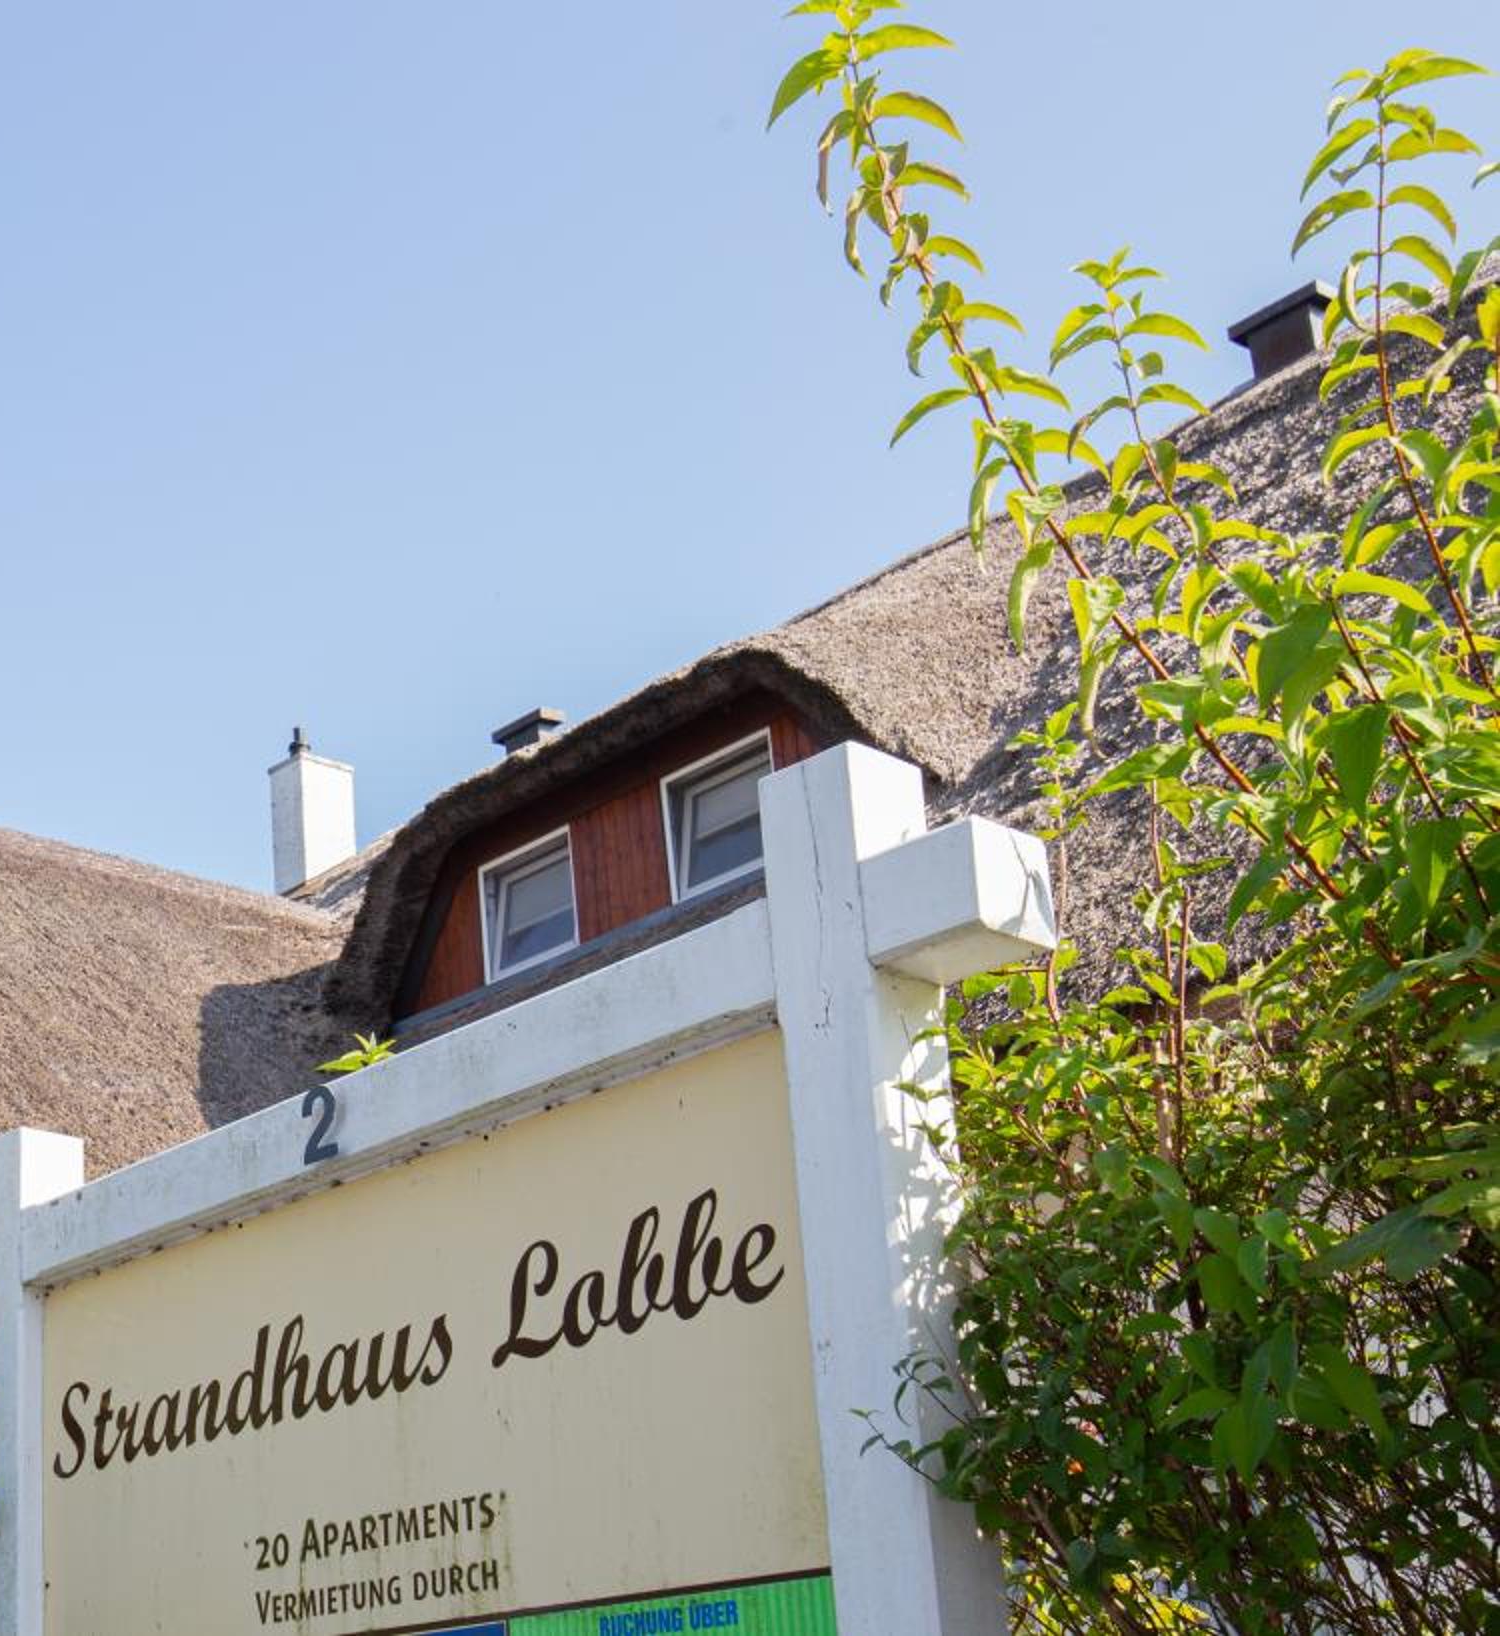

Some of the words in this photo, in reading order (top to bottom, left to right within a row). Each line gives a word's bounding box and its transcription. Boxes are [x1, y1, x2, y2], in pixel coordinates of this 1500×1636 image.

[302, 1086, 338, 1165] 2
[53, 1313, 454, 1479] Strandhaus
[491, 1188, 785, 1369] Lobbe
[255, 1533, 289, 1570] 20
[300, 1493, 495, 1562] APARTMENTS
[256, 1576, 401, 1624] VERMIETUNG
[413, 1559, 498, 1600] DURCH
[600, 1607, 683, 1636] BUCHUNG
[689, 1600, 739, 1628] ÜBER
